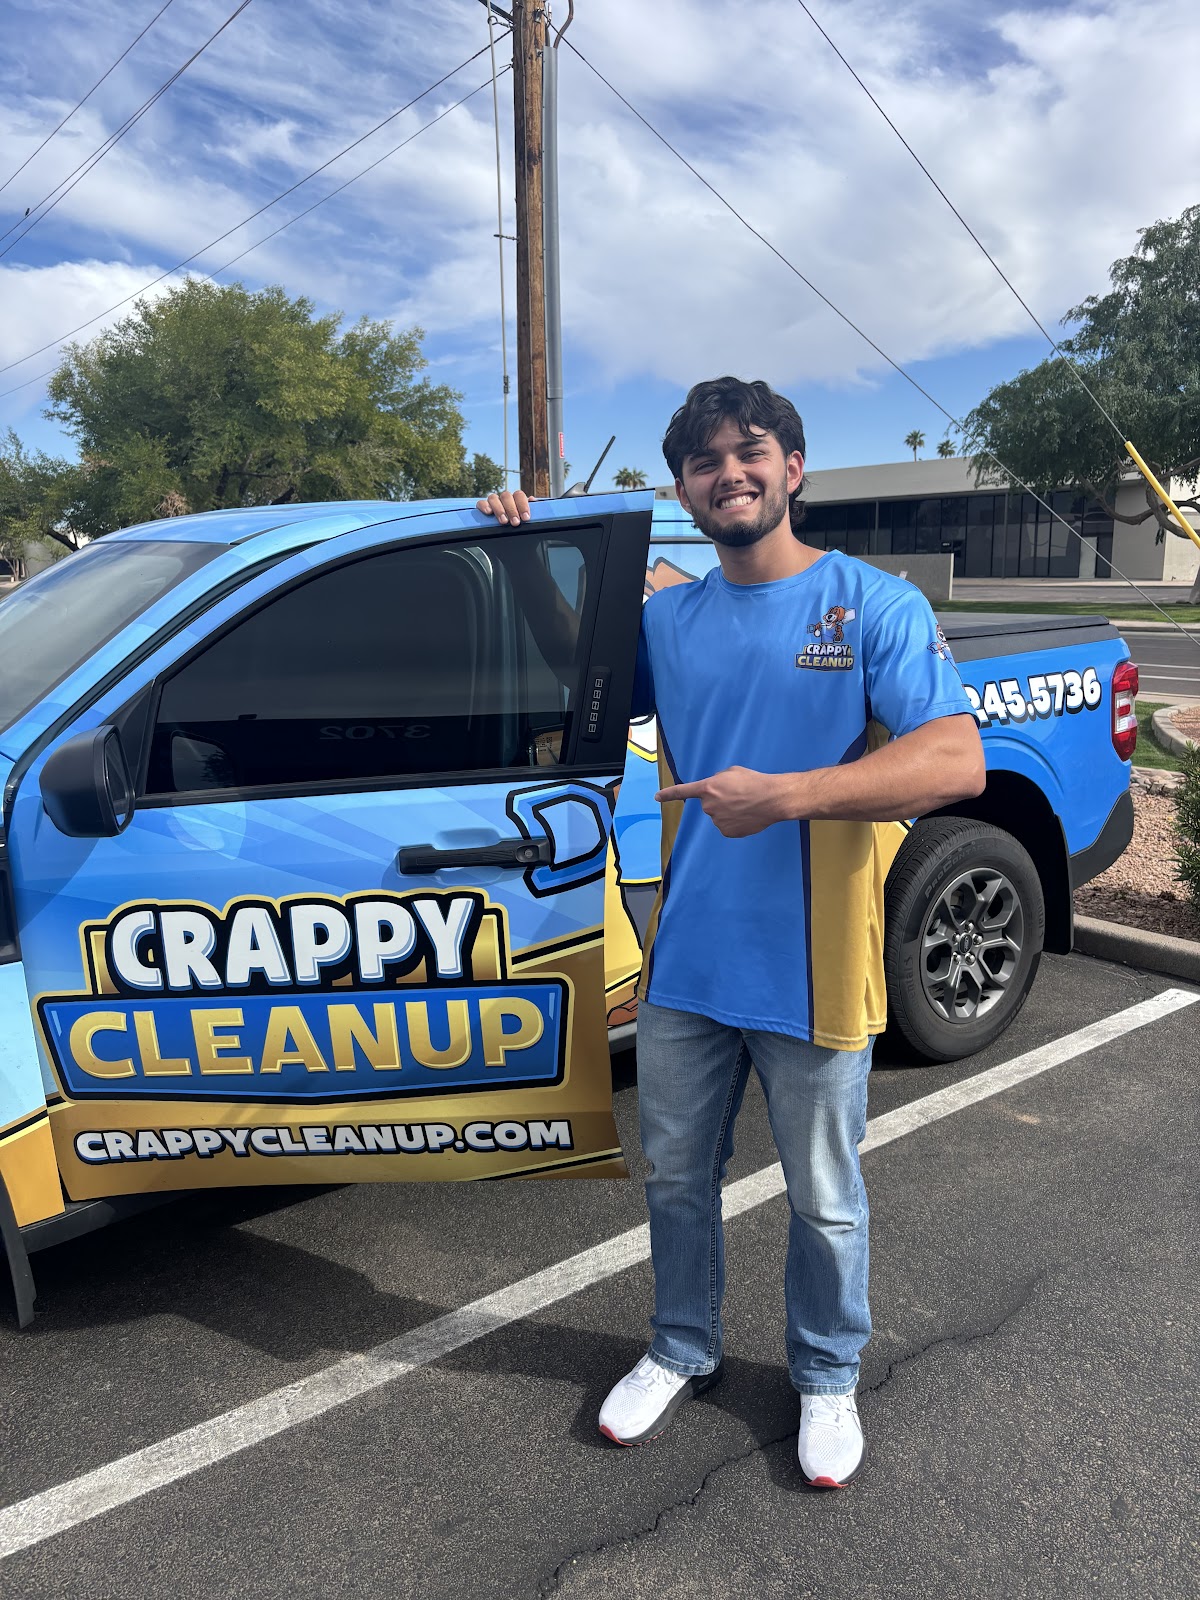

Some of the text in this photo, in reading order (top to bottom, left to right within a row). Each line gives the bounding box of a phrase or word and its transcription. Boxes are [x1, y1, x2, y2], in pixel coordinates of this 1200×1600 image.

[797, 655, 854, 669] CLEANUP
[806, 643, 849, 656] CRAPPY
[111, 898, 474, 990] CRAPPY
[69, 997, 545, 1078] CLEANUP
[76, 1121, 572, 1163] CRAPPYCLEANUP.COM
